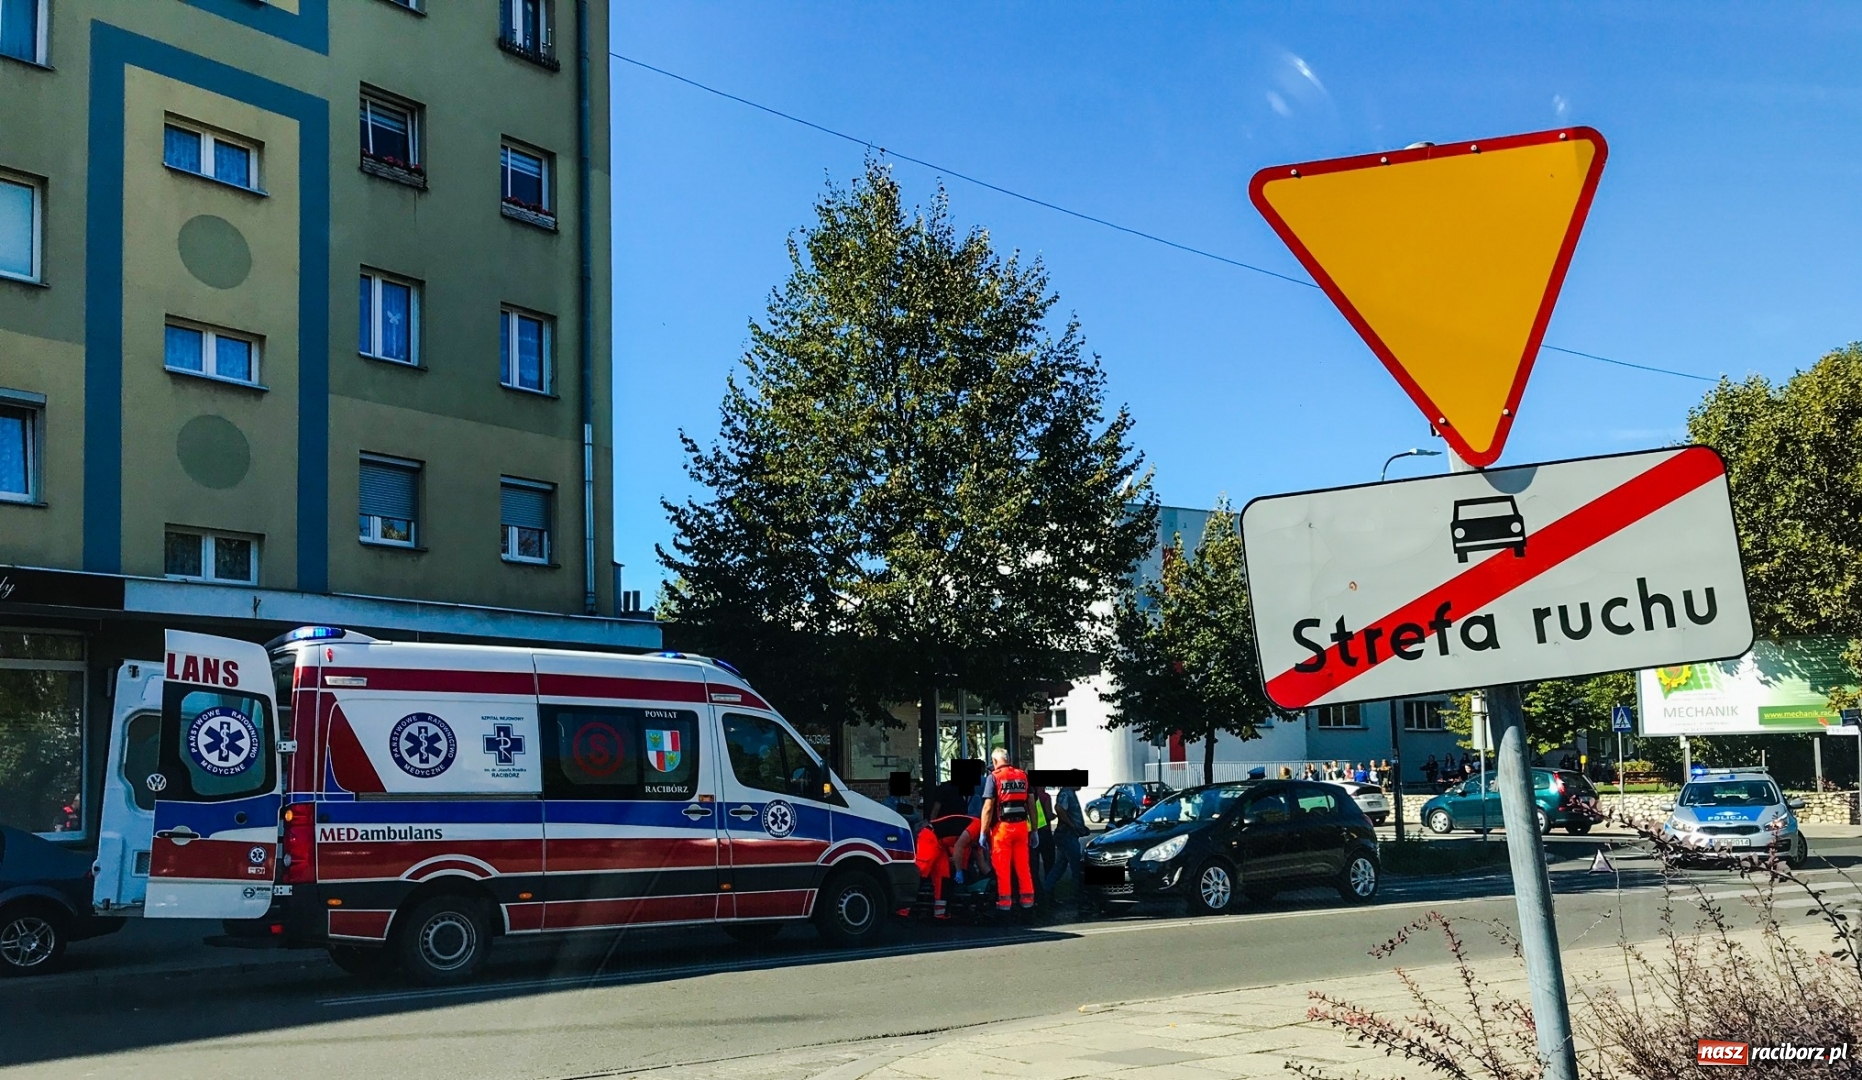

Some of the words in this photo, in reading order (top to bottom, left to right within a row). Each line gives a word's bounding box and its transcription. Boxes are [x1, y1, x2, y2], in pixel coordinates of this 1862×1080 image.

[1293, 601, 1500, 674] Strefa
[1532, 577, 1718, 645] ruchu
[166, 652, 239, 688] LANS
[645, 710, 678, 719] POWIAT
[1663, 705, 1739, 719] MECHANIK
[190, 709, 221, 753] PAŃSTWOWE
[231, 710, 258, 759] RATOWNICTWO
[427, 715, 456, 758] RATOWNICTWO
[200, 760, 246, 775] MEDYCZNE
[403, 763, 446, 776] MEDYCZNE
[645, 783, 689, 794] RACIBÓRZ
[319, 825, 443, 842] MEDambulans
